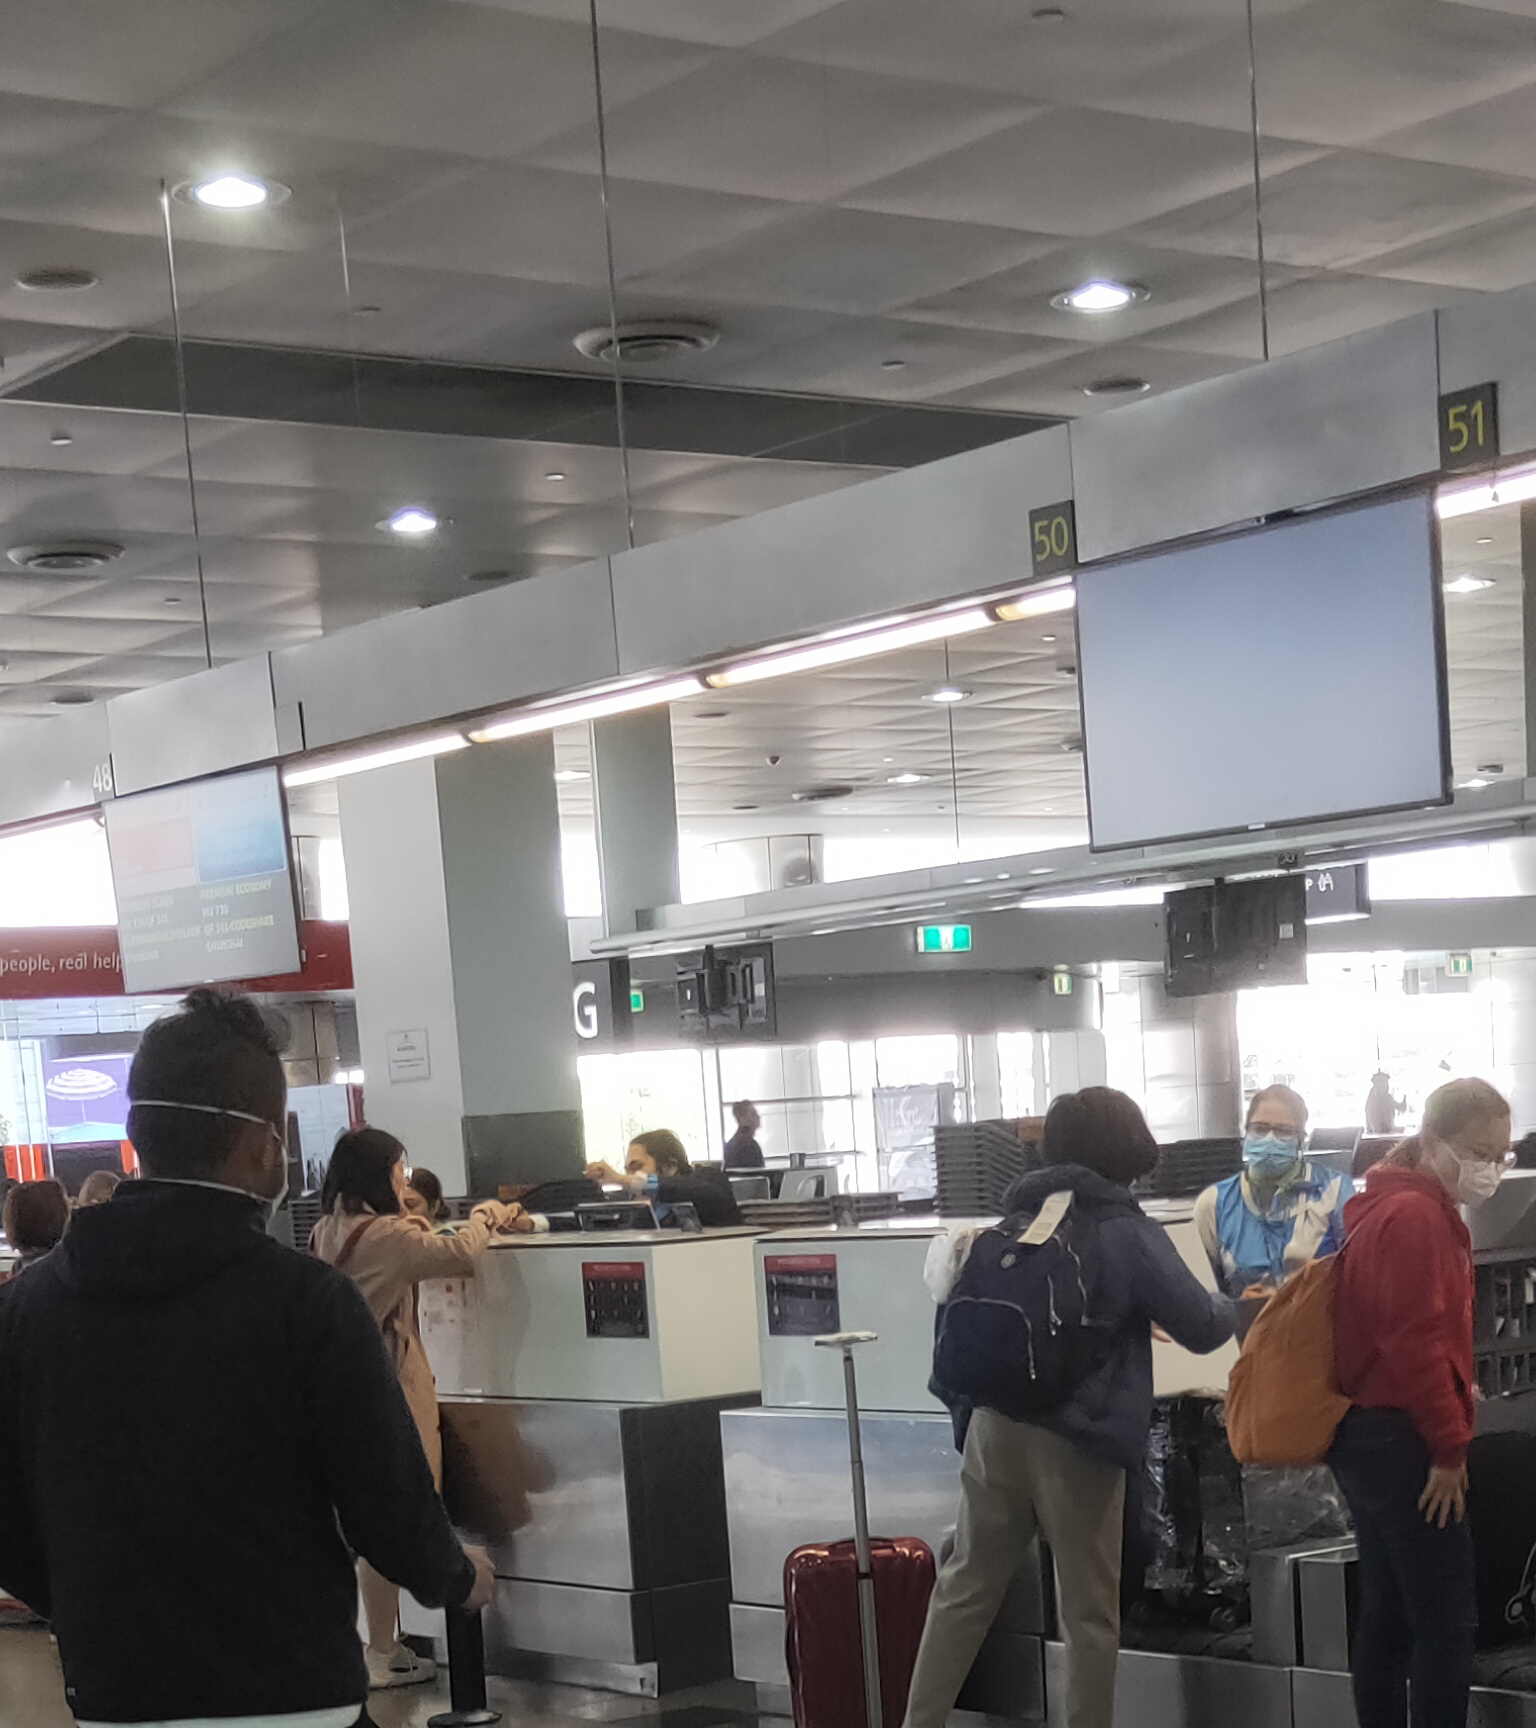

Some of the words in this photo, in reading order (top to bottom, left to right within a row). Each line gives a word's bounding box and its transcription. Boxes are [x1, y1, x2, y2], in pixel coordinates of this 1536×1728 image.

[1448, 399, 1484, 453] 51
[1034, 516, 1069, 561] 50
[92, 763, 113, 793] 48
[0, 954, 56, 977] people,
[59, 951, 88, 971] real
[573, 981, 598, 1039] G
